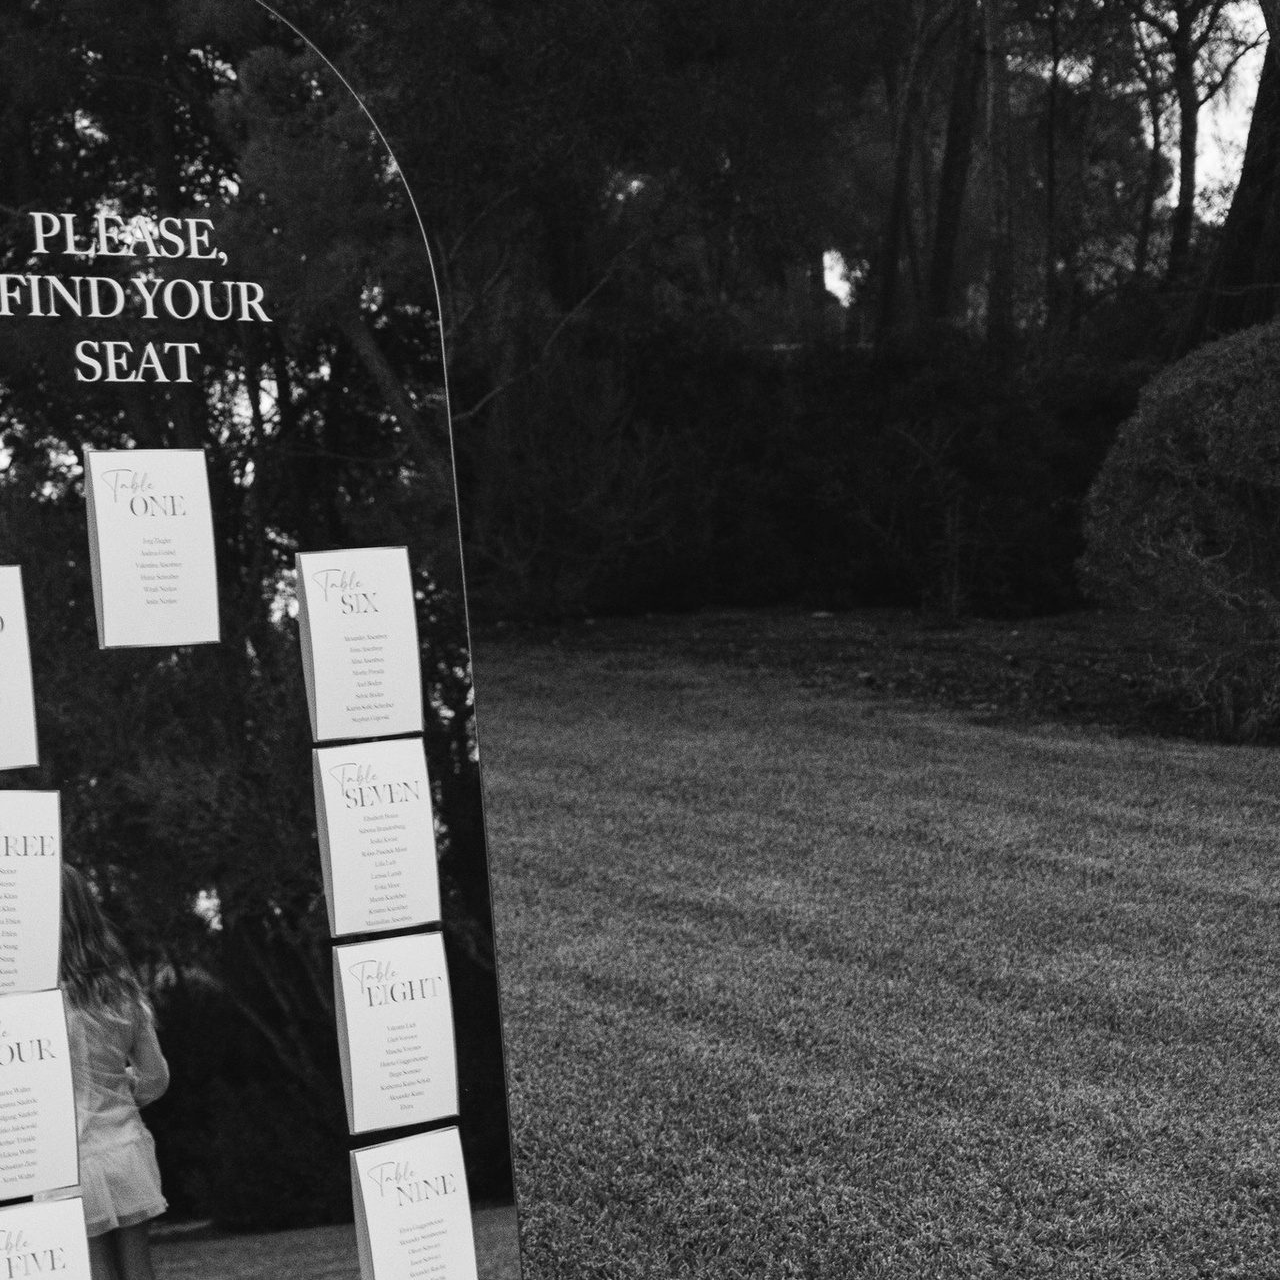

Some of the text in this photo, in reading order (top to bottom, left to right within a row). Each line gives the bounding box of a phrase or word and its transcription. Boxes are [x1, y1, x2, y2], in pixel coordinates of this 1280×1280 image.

[29, 212, 228, 266] PLEASE,
[130, 278, 273, 322] YOUR
[75, 340, 201, 382] SEAT
[101, 468, 154, 503] Table
[130, 495, 186, 517] ONE
[312, 568, 363, 602] Table
[341, 592, 379, 615] SIX
[328, 762, 377, 797] Table
[345, 780, 420, 809] SEVEN
[349, 959, 398, 994] Table
[366, 976, 443, 1007] EIGHT
[367, 1161, 416, 1198] Table
[396, 1173, 456, 1206] NINE
[6, 1247, 66, 1279] FIVE
